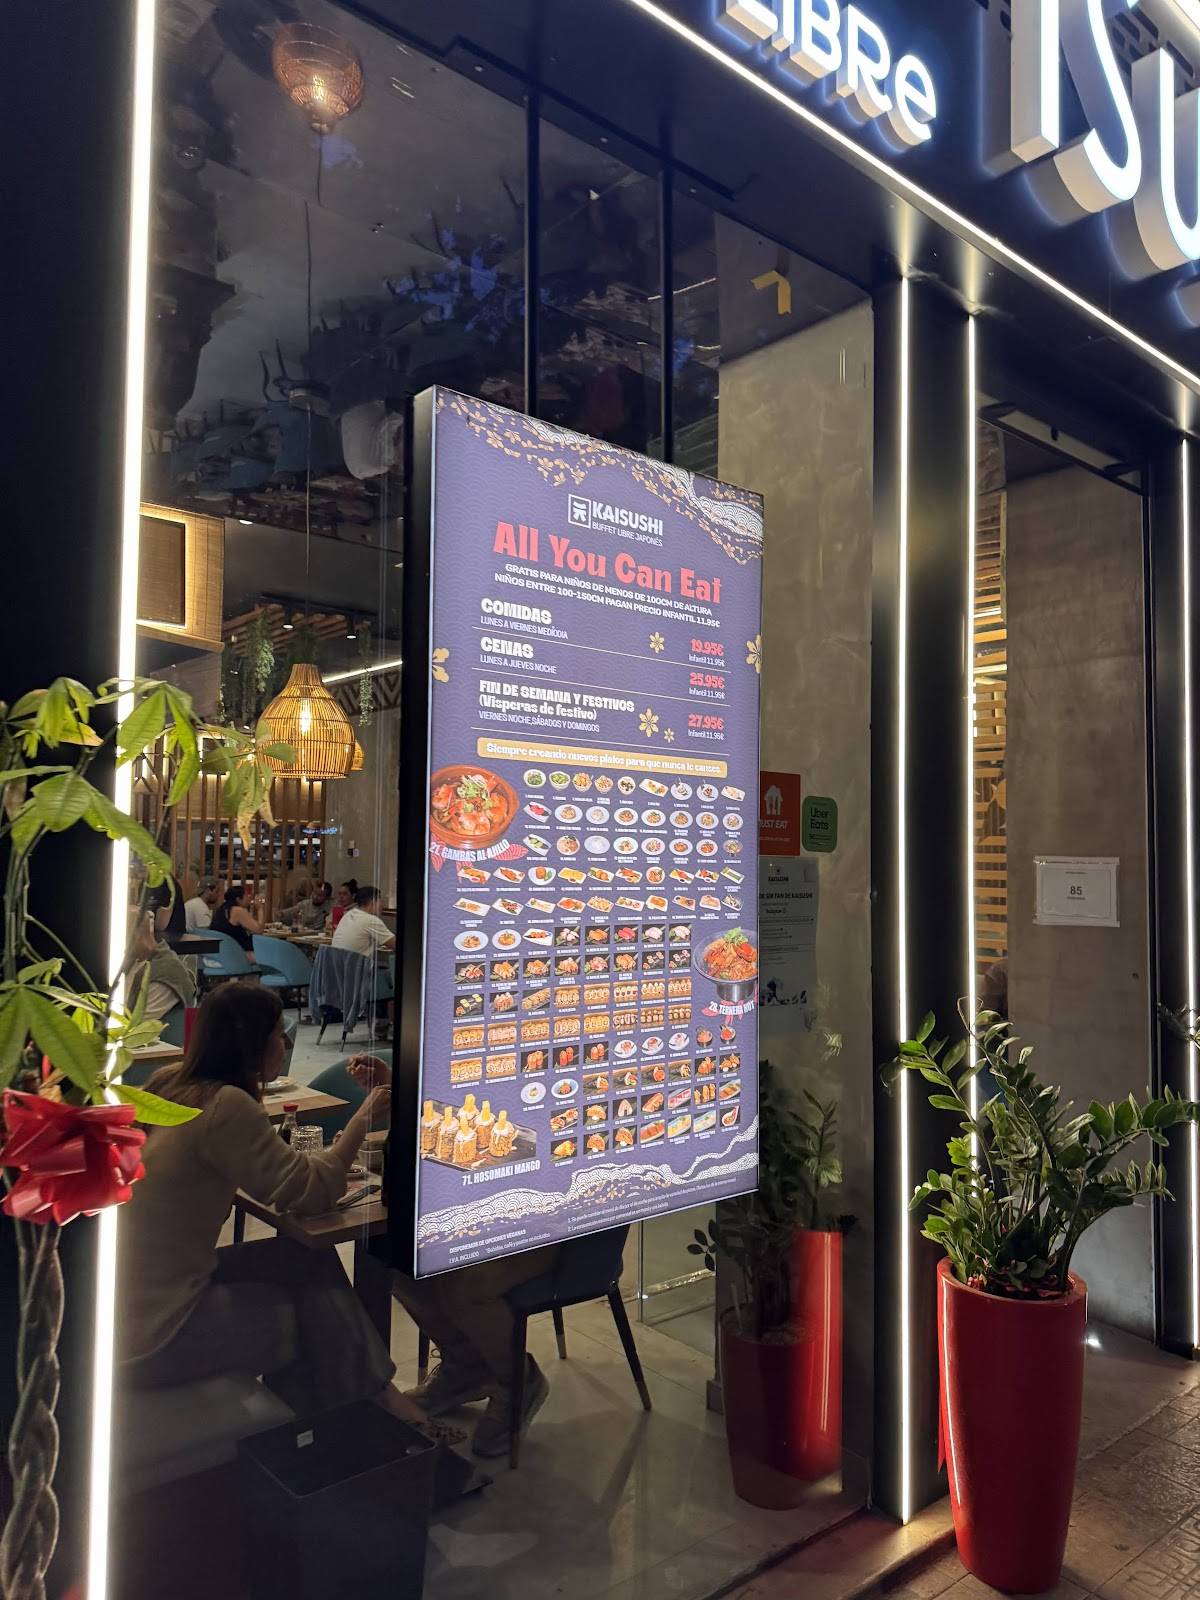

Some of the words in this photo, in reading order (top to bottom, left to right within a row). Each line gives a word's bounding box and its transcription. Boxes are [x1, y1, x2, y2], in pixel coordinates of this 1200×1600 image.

[727, 0, 937, 145] IBRe
[592, 500, 663, 536] KAISUSHI
[592, 522, 616, 535] BUFFET
[617, 528, 634, 540] LIBRE
[635, 532, 663, 546] JAPONÉS
[493, 520, 539, 562] All
[548, 534, 606, 578] You
[614, 552, 672, 594] Can
[680, 568, 722, 604] Eat
[505, 564, 539, 578] GRATIS
[540, 570, 564, 584] PARA
[564, 576, 591, 590] NIÑOS
[592, 584, 604, 593] DE
[604, 584, 634, 599] MENOS
[634, 591, 646, 602] DE
[646, 594, 674, 610] 100CM
[673, 600, 684, 610] DE
[684, 602, 712, 616] ALTURA
[494, 572, 526, 588] NIÑOS
[526, 580, 556, 594] ENTRE
[557, 586, 604, 605] 100-150CM
[605, 598, 632, 610] PAGAN
[633, 604, 662, 616] PRECIO
[662, 609, 696, 623] INFANTIL
[696, 616, 720, 628] 11.95€
[480, 598, 552, 625] COMIDAS
[480, 616, 504, 628] LUNES
[503, 620, 509, 628] A
[509, 621, 538, 634] VIERNES
[480, 636, 534, 659] CENAS
[690, 638, 724, 656] 19.95€
[480, 654, 503, 666] LUNES
[503, 659, 509, 667] A
[509, 659, 535, 672] JUEVES
[534, 663, 557, 674] NOCHE
[688, 654, 706, 665] Infantil
[689, 672, 726, 690] 25.95€
[479, 680, 501, 695] FIN
[502, 683, 520, 698] DE
[520, 686, 572, 705] SEMANA
[573, 692, 582, 705] Y
[583, 694, 635, 712] FESTIVOS
[688, 687, 706, 698] Infantil
[478, 710, 508, 722] VIERNES
[567, 722, 600, 732] DOMINGOS
[540, 702, 555, 716] de
[556, 704, 597, 721] festivo)
[688, 713, 724, 730] 27.95€
[688, 729, 706, 740] Infantil
[706, 731, 724, 740] 11.95€
[486, 742, 528, 758] Siempre
[528, 748, 567, 760] creando
[567, 754, 600, 763] nuevos
[600, 753, 624, 766] platos
[625, 759, 646, 768] para
[646, 760, 661, 769] que
[662, 761, 685, 770] nunca
[810, 807, 828, 818] Uber
[759, 820, 775, 829] UST
[776, 820, 788, 830] EAT
[810, 819, 829, 830] Eats
[441, 846, 477, 862] GAMBAS
[476, 849, 487, 862] AL
[1070, 886, 1082, 896] 85
[719, 1004, 744, 1015] TERNERA
[462, 1176, 473, 1186] 71.
[473, 1166, 514, 1184] HOSOMAKI
[514, 1160, 541, 1174] MANGO
